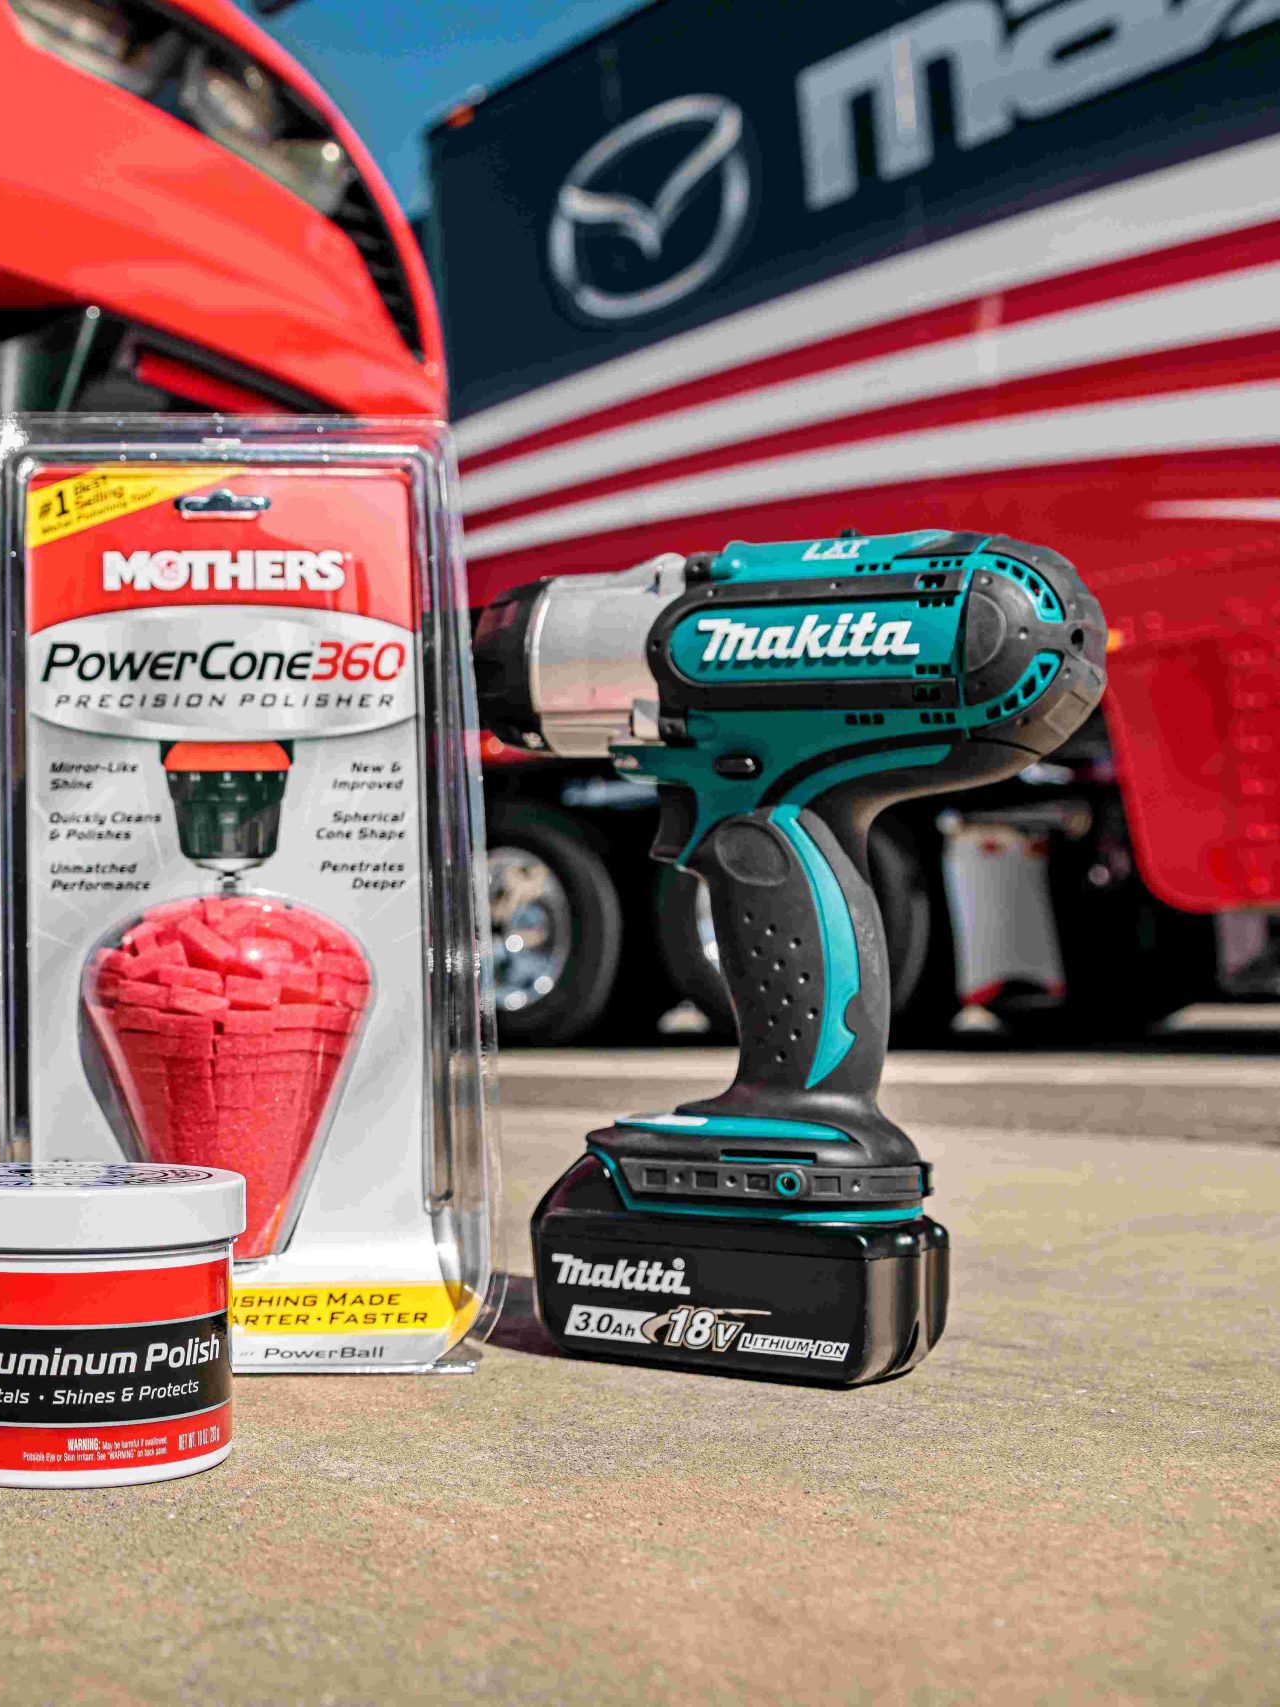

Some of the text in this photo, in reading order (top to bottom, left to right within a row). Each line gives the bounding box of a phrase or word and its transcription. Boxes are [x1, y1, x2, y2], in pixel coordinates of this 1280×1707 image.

[795, 0, 1280, 212] ma
[39, 488, 70, 520] #1
[801, 540, 871, 561] LXT
[103, 550, 346, 592] MOTHERS
[41, 641, 407, 683] PowerCone360
[54, 693, 395, 709] PRECISION POLISHER
[49, 761, 139, 774] Mirror-Like
[351, 761, 402, 773] New &
[50, 777, 93, 791] Shine
[332, 779, 404, 791] Improved
[49, 811, 162, 825] Quickly Cleans
[333, 811, 405, 824] Spherical
[49, 829, 132, 840] & Polishes
[316, 827, 406, 840] Cone Shape
[50, 863, 138, 875] Unmatched
[321, 860, 405, 872] Penetrates
[51, 879, 151, 891] Performance
[352, 877, 406, 890] Deeper
[326, 1293, 401, 1307] MADE
[329, 1311, 428, 1325] FASTER
[574, 1311, 635, 1337] 3.0Ah
[738, 1334, 850, 1362] LITHIUM-ION
[144, 1334, 220, 1372] Polish
[263, 1346, 384, 1359] PowerBall
[52, 1389, 116, 1405] Shines
[121, 1387, 134, 1402] &
[138, 1380, 199, 1401] Protects
[67, 1438, 101, 1451] WARNING:
[102, 1440, 113, 1451] May
[96, 1450, 107, 1461] See
